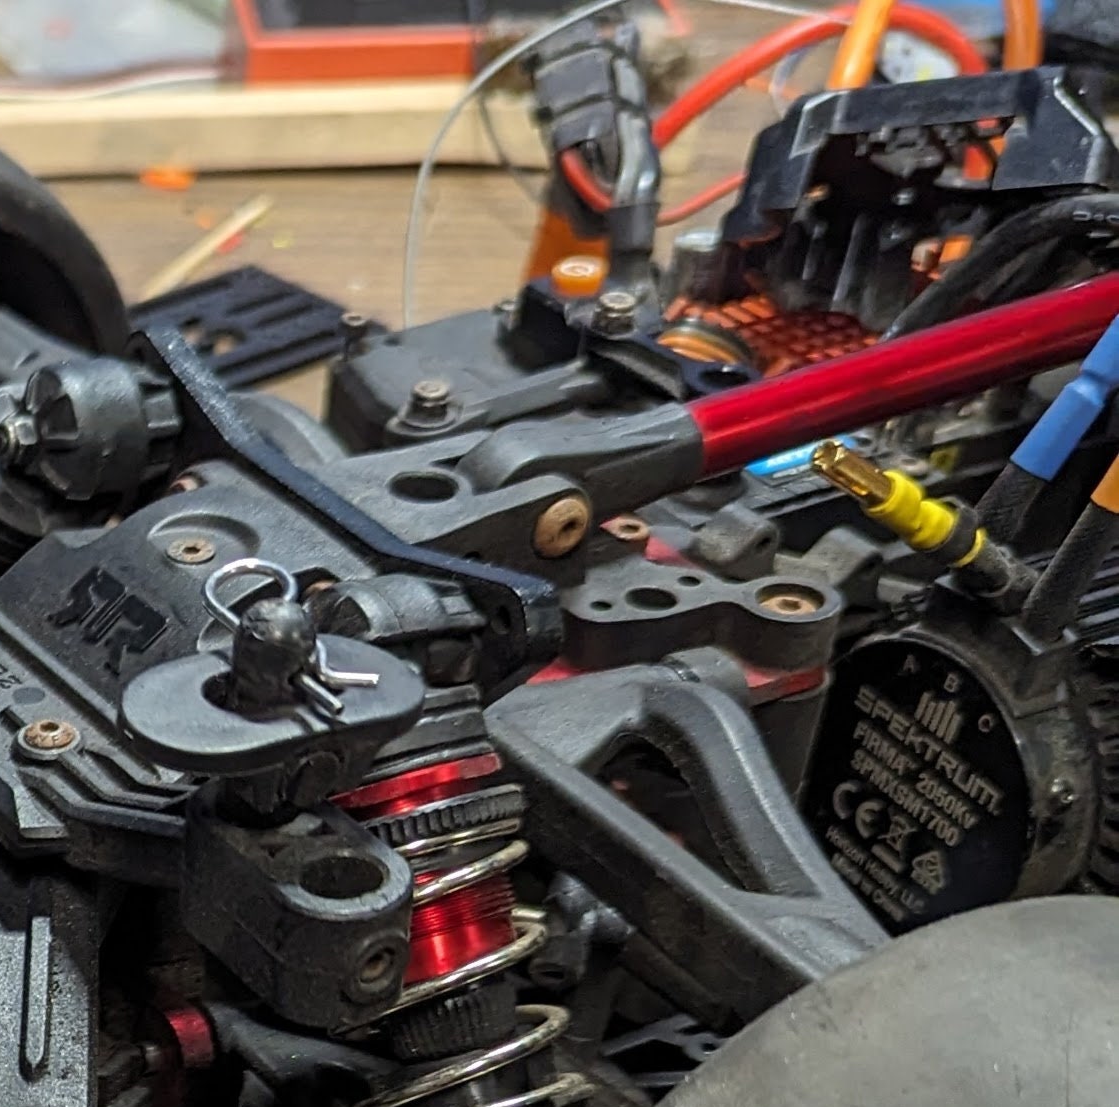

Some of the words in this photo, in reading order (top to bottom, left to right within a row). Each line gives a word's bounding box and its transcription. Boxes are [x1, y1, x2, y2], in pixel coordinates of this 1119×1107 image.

[900, 653, 919, 676] A
[943, 672, 961, 694] B
[977, 713, 994, 734] C
